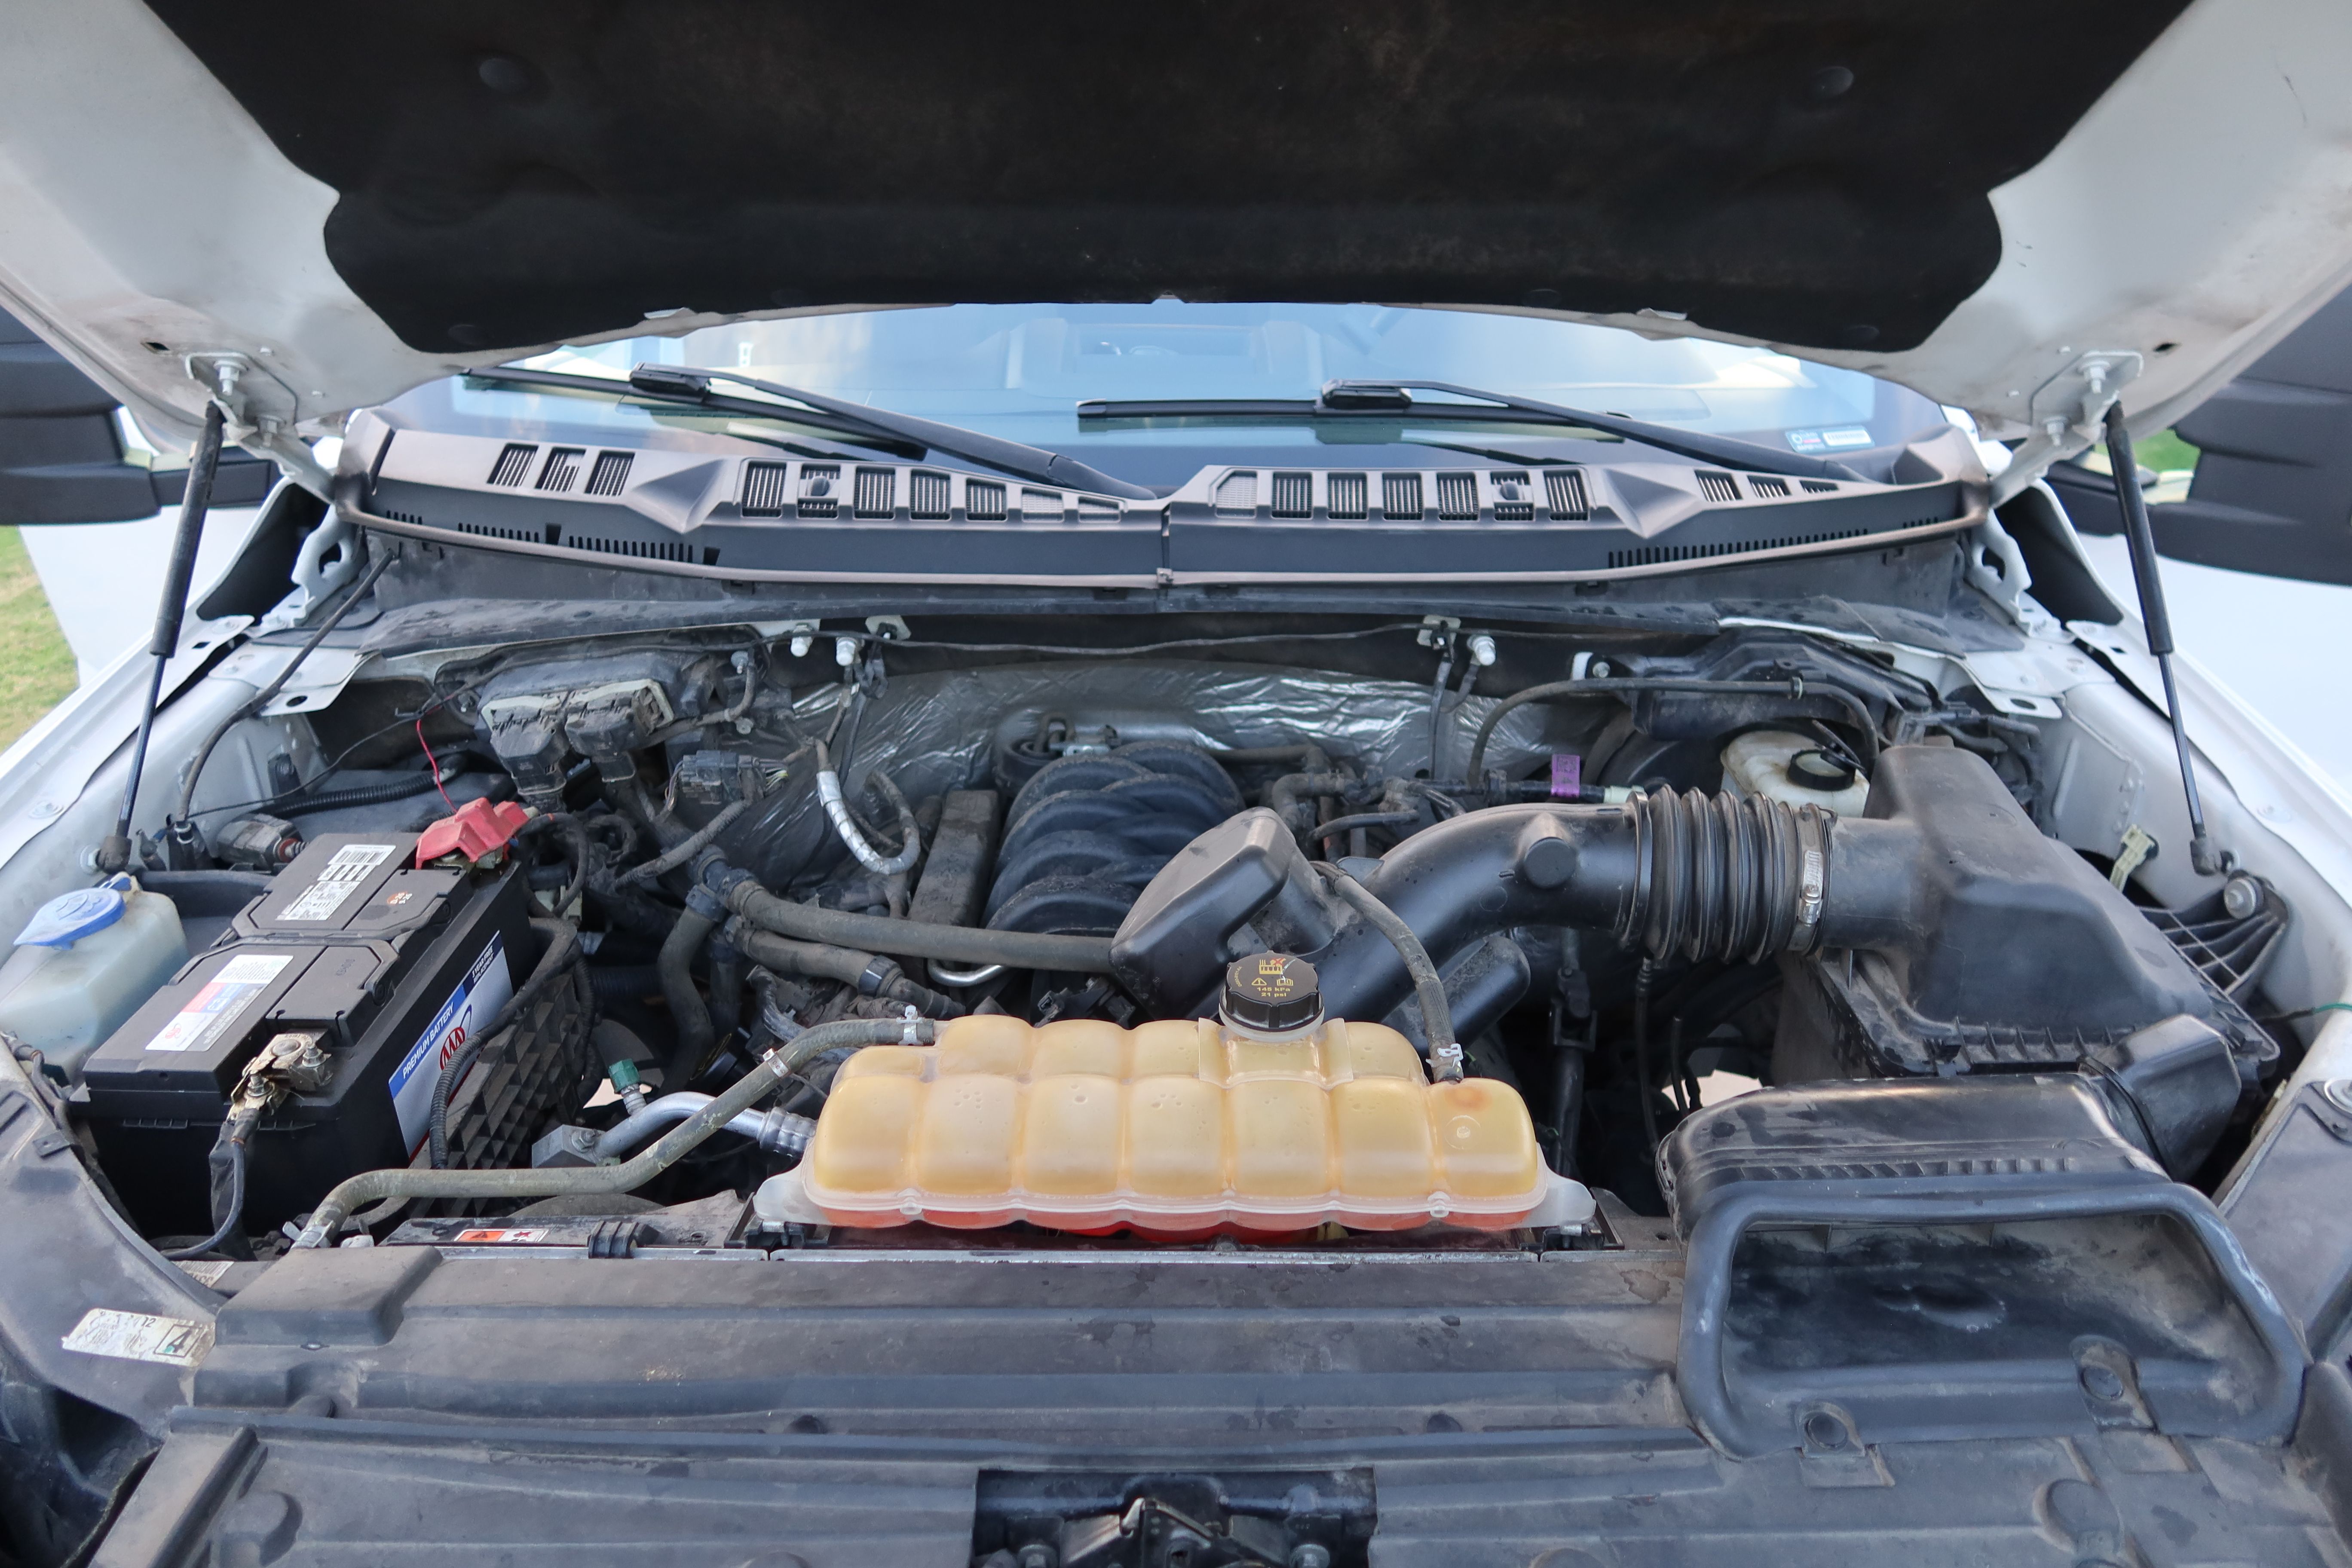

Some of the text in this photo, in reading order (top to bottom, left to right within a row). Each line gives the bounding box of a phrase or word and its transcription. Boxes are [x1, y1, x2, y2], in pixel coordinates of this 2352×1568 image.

[474, 957, 484, 974] YEAR
[484, 945, 493, 962] FREE
[402, 1001, 454, 1079] PREMIUM BATTERY
[440, 1027, 466, 1070] AAA
